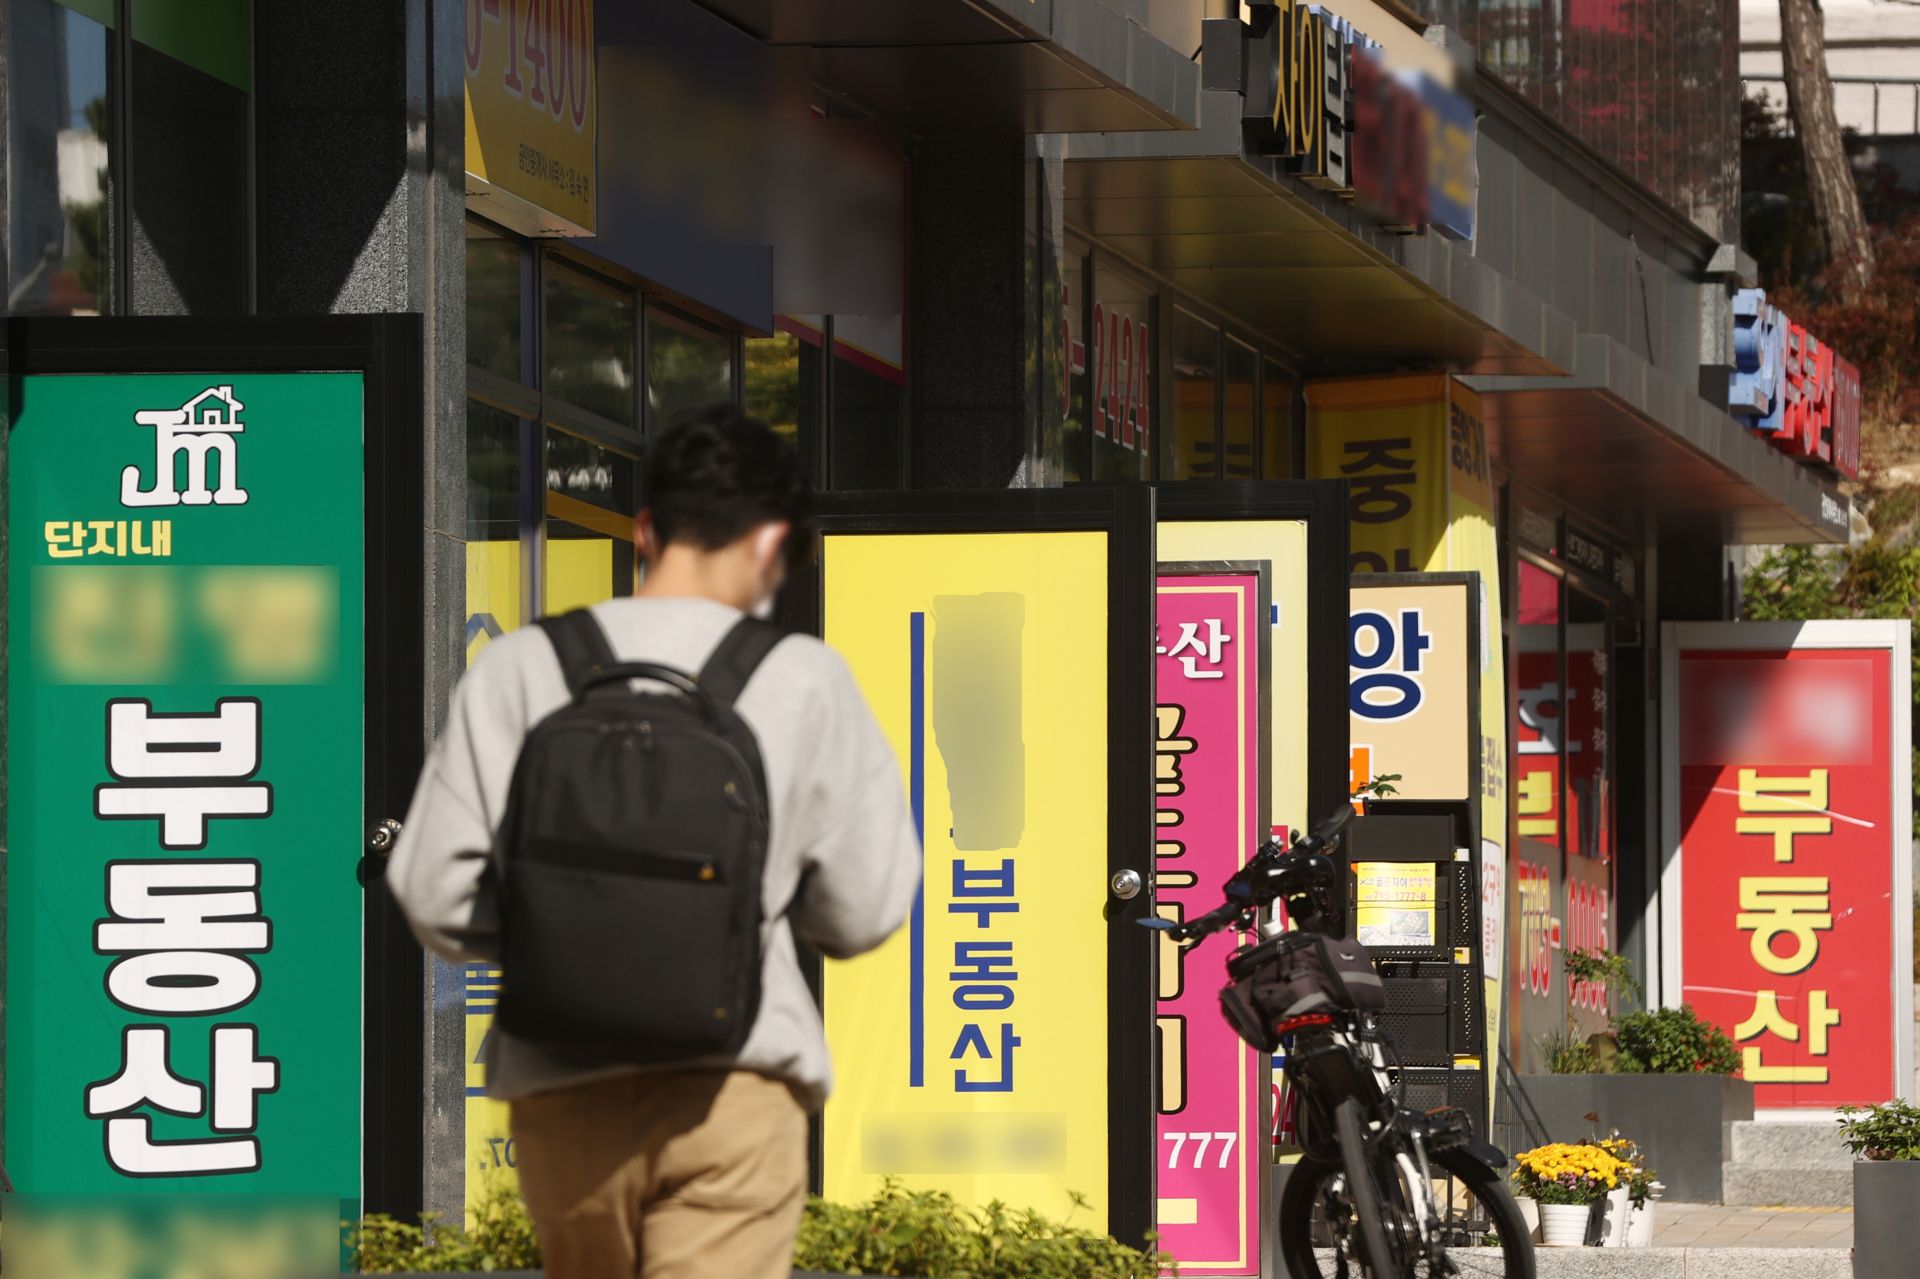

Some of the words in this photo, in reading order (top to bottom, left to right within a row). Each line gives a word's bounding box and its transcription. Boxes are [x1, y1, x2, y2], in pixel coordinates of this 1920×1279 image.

[44, 518, 173, 560] 단지내
[1156, 618, 1232, 679] 산
[84, 694, 281, 1180] 부동산
[949, 858, 1022, 1093] 부동산
[1735, 768, 1840, 1085] 부동산
